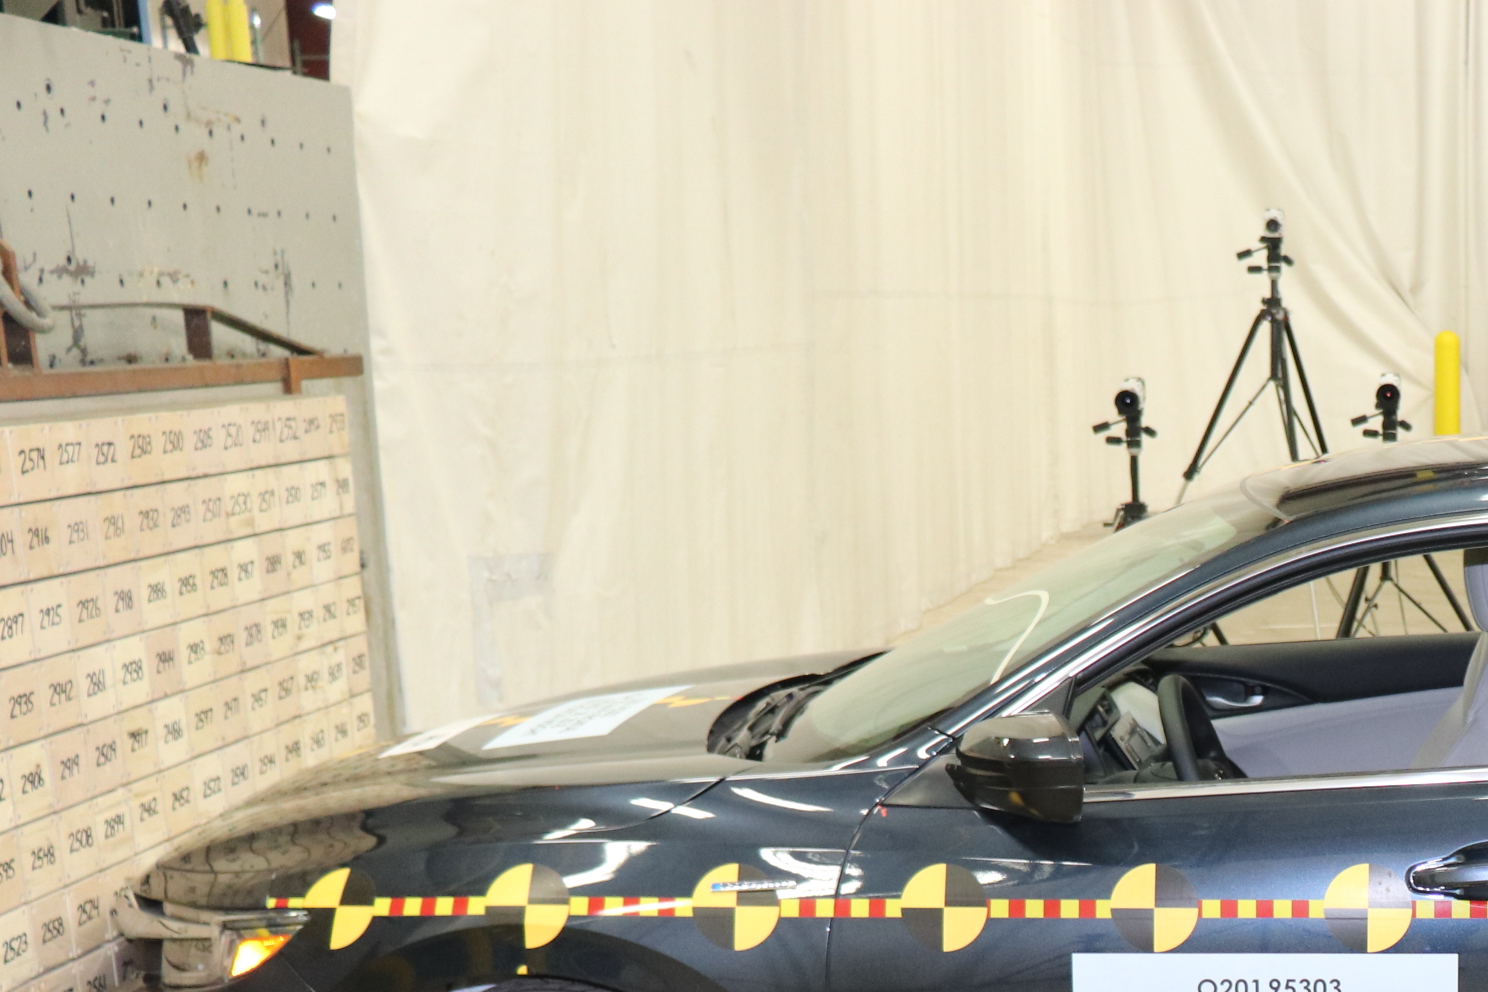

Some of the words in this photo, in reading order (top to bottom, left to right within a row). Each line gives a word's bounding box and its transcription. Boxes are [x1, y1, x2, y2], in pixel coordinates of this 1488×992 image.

[18, 447, 46, 475] 2574
[57, 441, 82, 466] 2527
[94, 441, 117, 466] 2572
[130, 433, 152, 459] 2503
[162, 430, 184, 454] 2500
[193, 427, 213, 451] 2505
[27, 527, 51, 550] 2916
[67, 521, 89, 545] 2931
[103, 514, 125, 541] 2961
[138, 508, 160, 532] 2932
[0, 612, 25, 641] 2897
[39, 603, 62, 630] 2925
[76, 595, 101, 623] 2926
[113, 588, 134, 614] 2918
[147, 580, 167, 604] 2886
[9, 691, 35, 720] 2935
[49, 679, 74, 707] 2942
[86, 668, 106, 698] 2861
[121, 658, 144, 686] 2938
[20, 769, 45, 795] 2906
[60, 753, 80, 780] 2919
[95, 740, 117, 768] 2509
[163, 718, 184, 745] 2486
[31, 842, 56, 871] 2548
[68, 826, 94, 854] 2508
[2, 931, 29, 965] 2523
[41, 915, 66, 945] 2558
[77, 895, 100, 928] 2524
